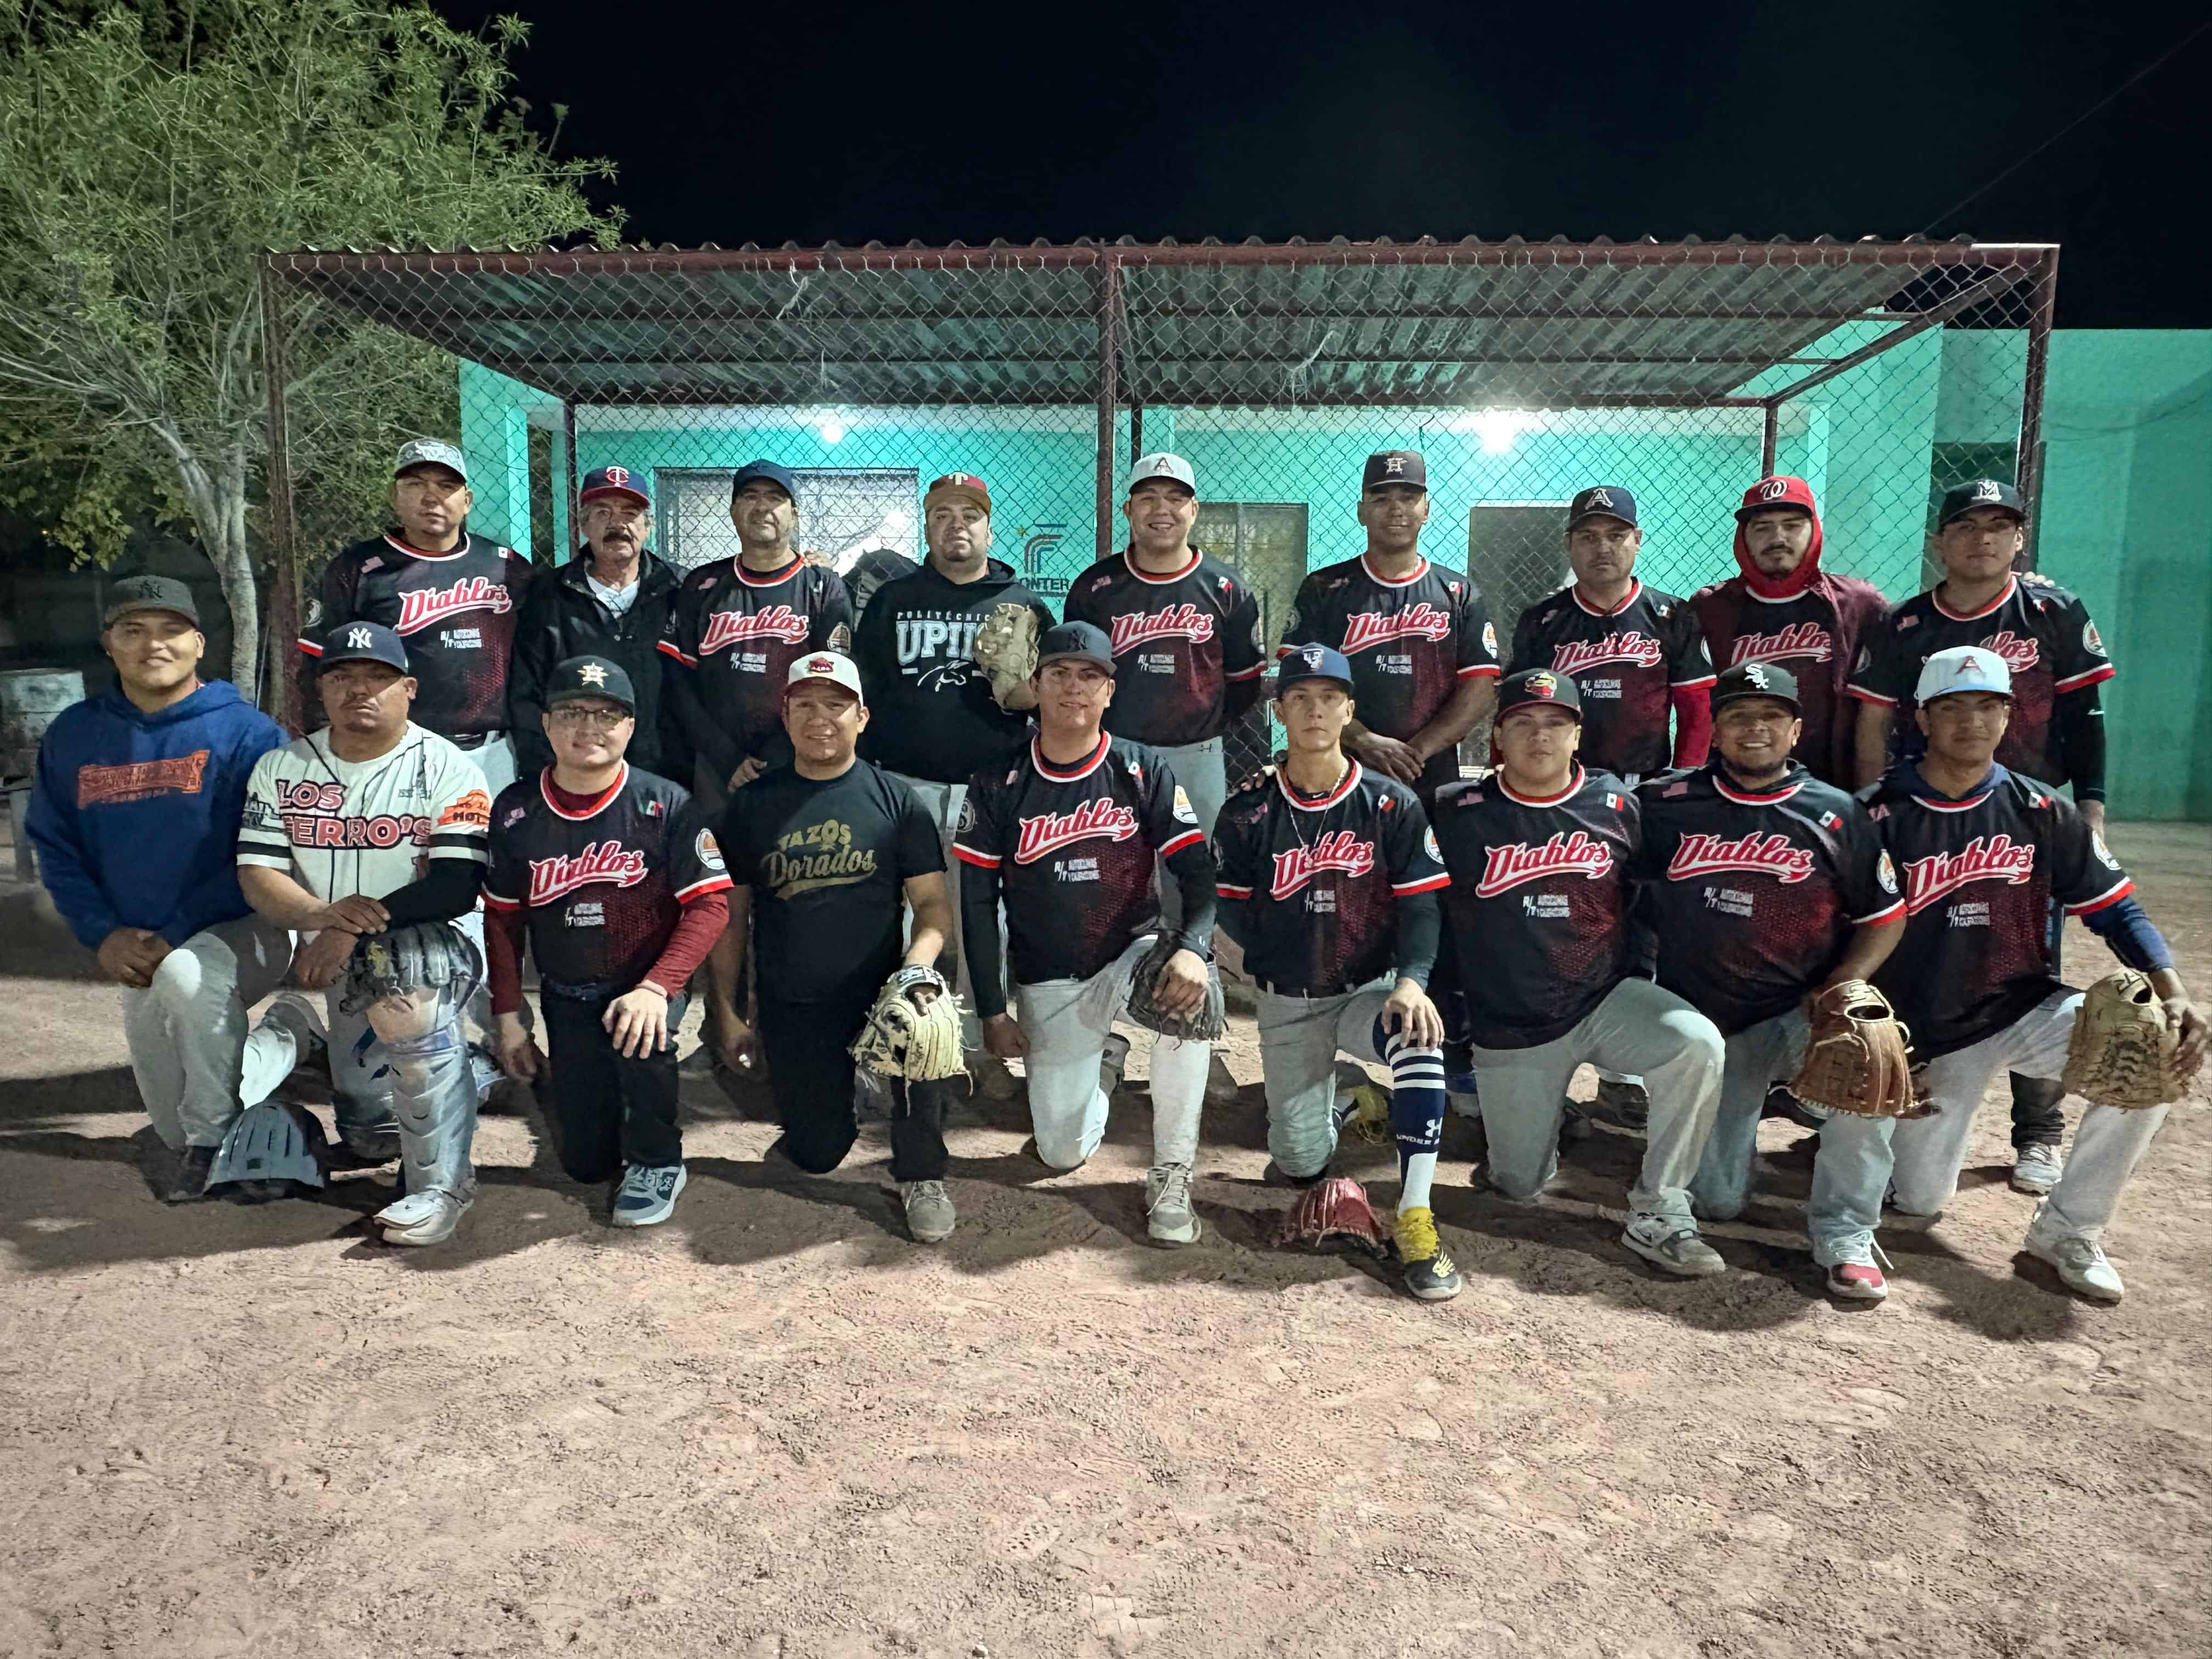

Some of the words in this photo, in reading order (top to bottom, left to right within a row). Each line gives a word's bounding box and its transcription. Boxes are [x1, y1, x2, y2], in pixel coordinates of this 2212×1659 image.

[1584, 488, 1614, 511] A
[396, 577, 511, 631] Diablos
[701, 605, 809, 651] Diablos
[1111, 603, 1214, 653] Diablos
[1341, 602, 1450, 652] Diablos
[347, 628, 372, 648] NY
[275, 779, 345, 811] LOS
[1017, 797, 1136, 861] Diablos
[529, 840, 646, 902] Diablos
[760, 844, 878, 887] Dorados
[1479, 831, 1612, 894] Diablos
[1668, 831, 1815, 878] Diablos
[1902, 834, 2035, 911] Diablos
